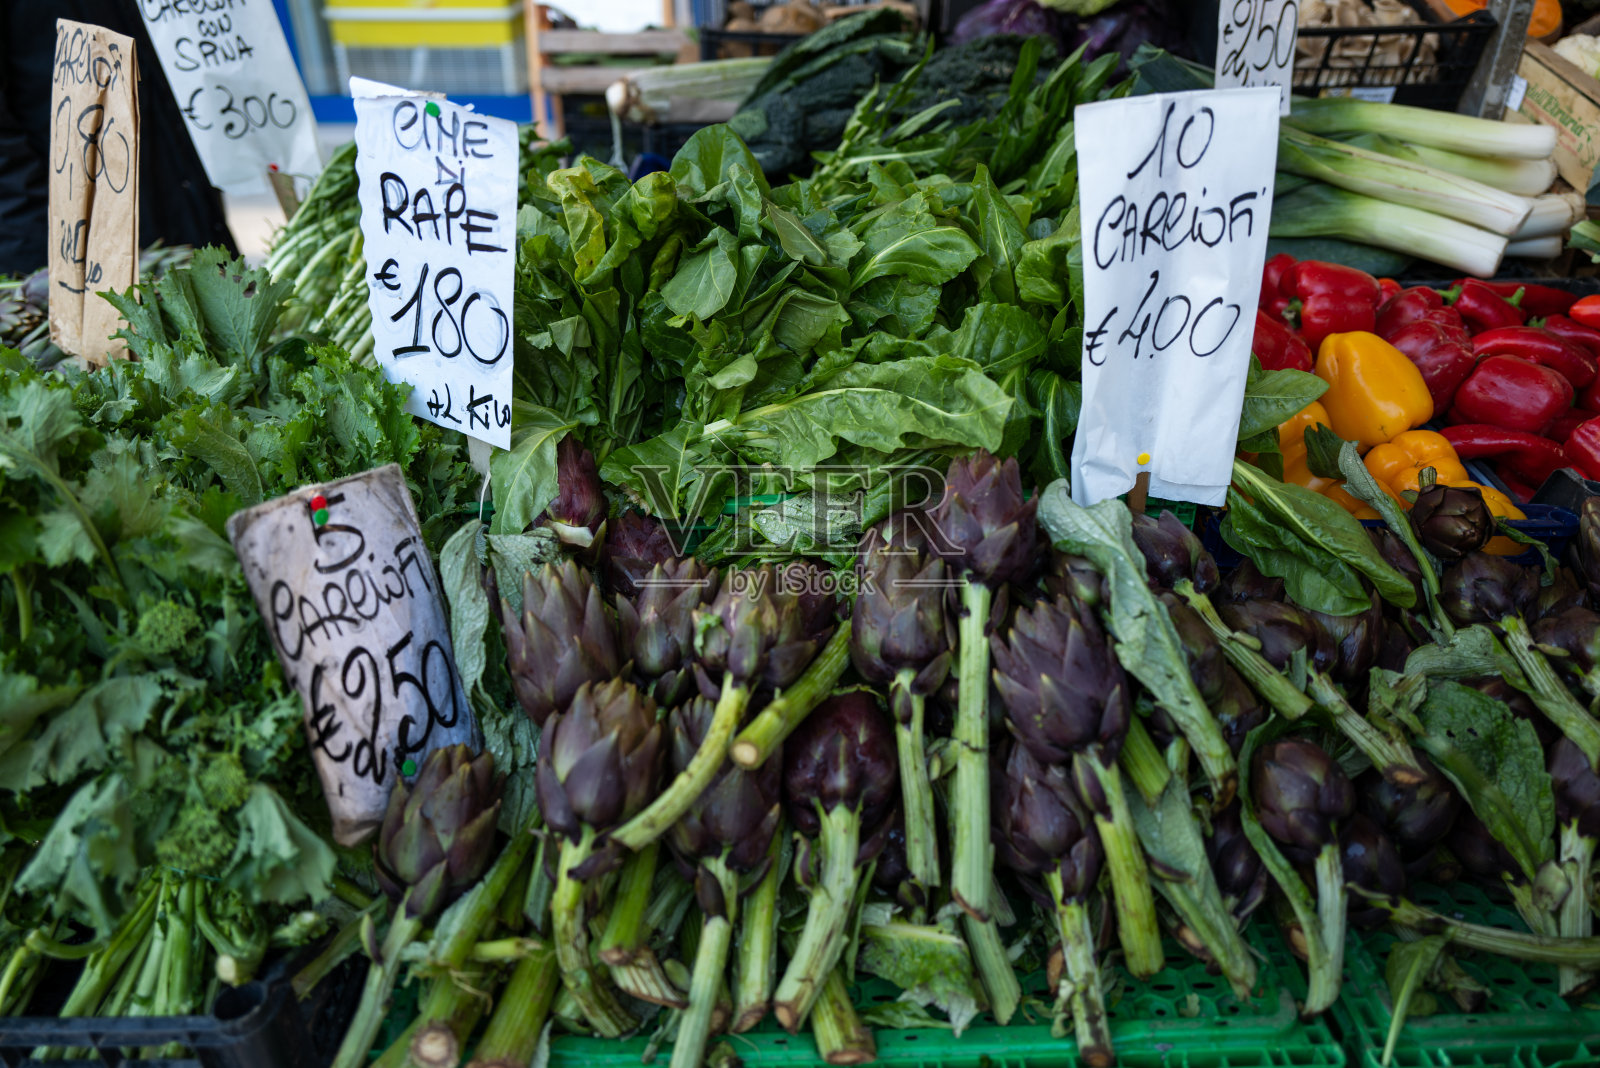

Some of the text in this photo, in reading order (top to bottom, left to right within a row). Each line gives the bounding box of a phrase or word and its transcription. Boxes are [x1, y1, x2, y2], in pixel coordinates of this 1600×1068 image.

[1127, 102, 1215, 180] 10
[380, 171, 508, 254] RAPE
[306, 493, 366, 575] 5
